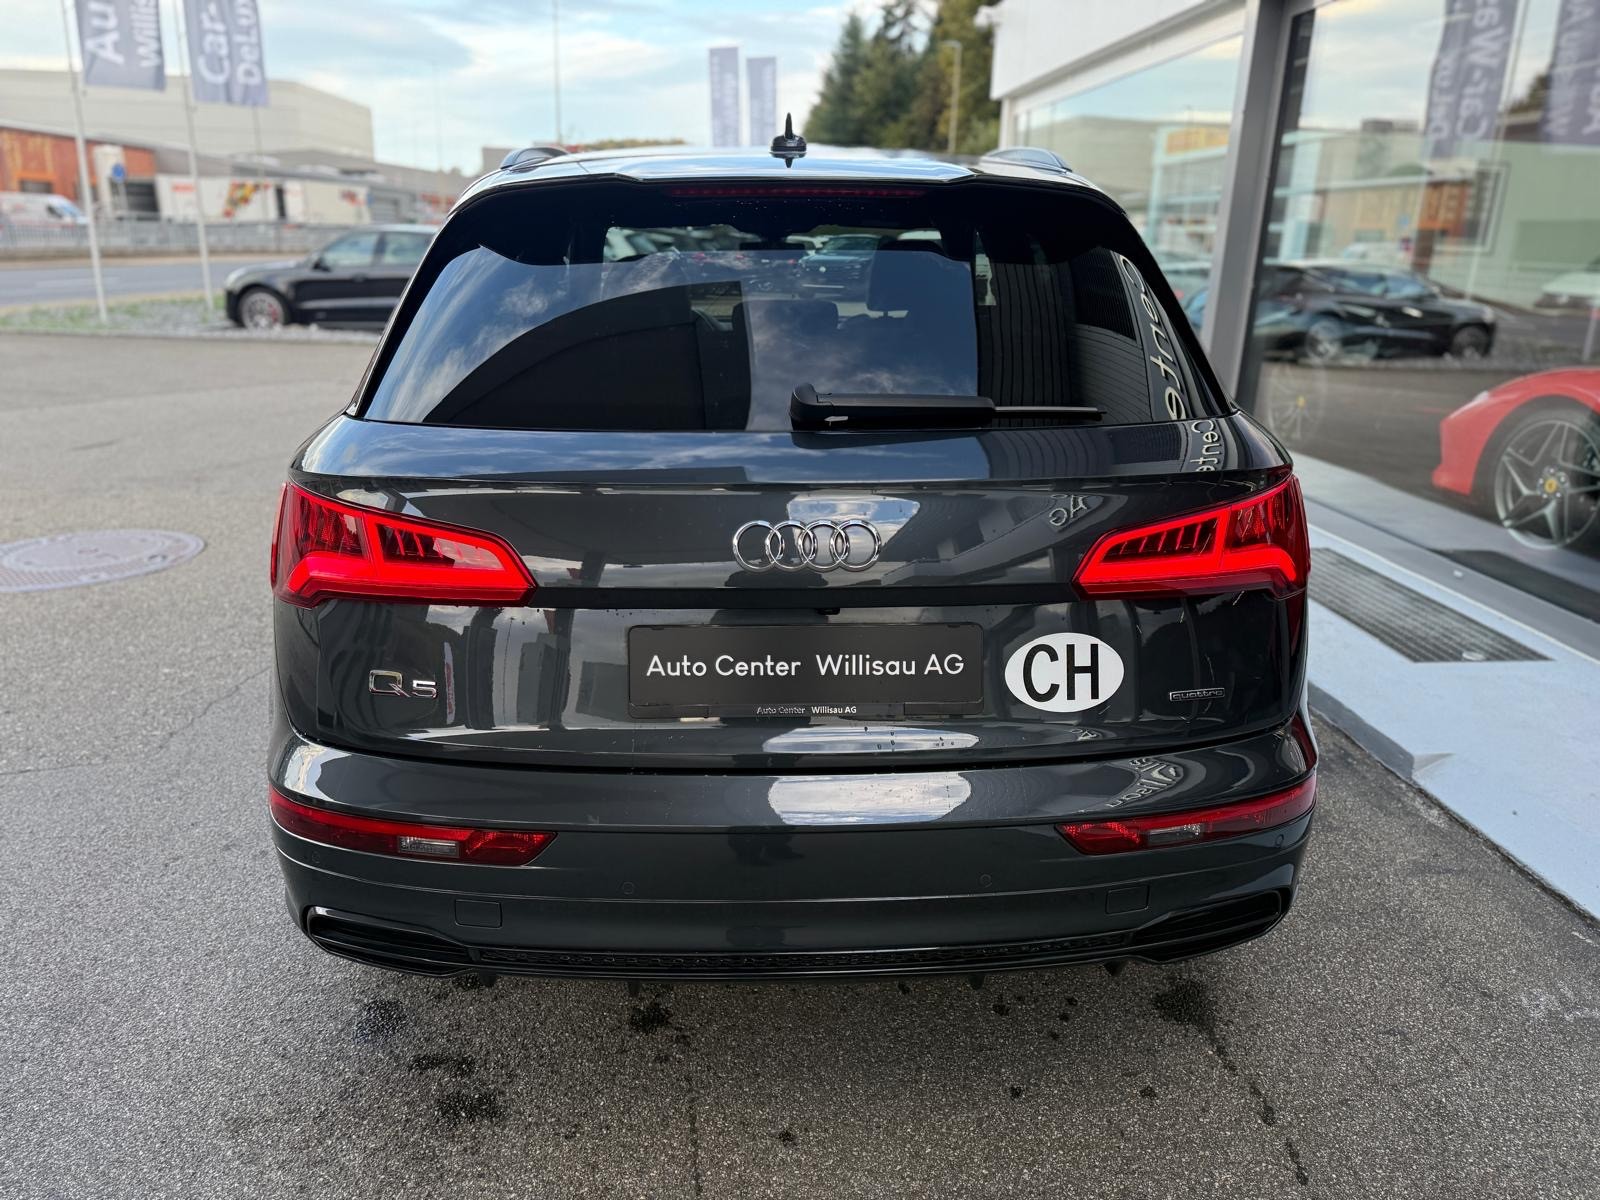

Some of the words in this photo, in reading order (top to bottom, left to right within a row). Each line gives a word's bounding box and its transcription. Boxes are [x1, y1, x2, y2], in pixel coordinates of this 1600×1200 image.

[646, 655, 707, 677] Auto
[715, 655, 801, 677] Center
[816, 654, 916, 676] Willisau
[924, 653, 965, 675] AG
[1022, 643, 1100, 703] CH
[369, 669, 438, 698] Q5
[1170, 688, 1224, 700] quattro
[756, 705, 777, 715] Auto
[778, 705, 806, 715] Center
[811, 705, 843, 715] Willisau
[844, 705, 857, 715] AG
